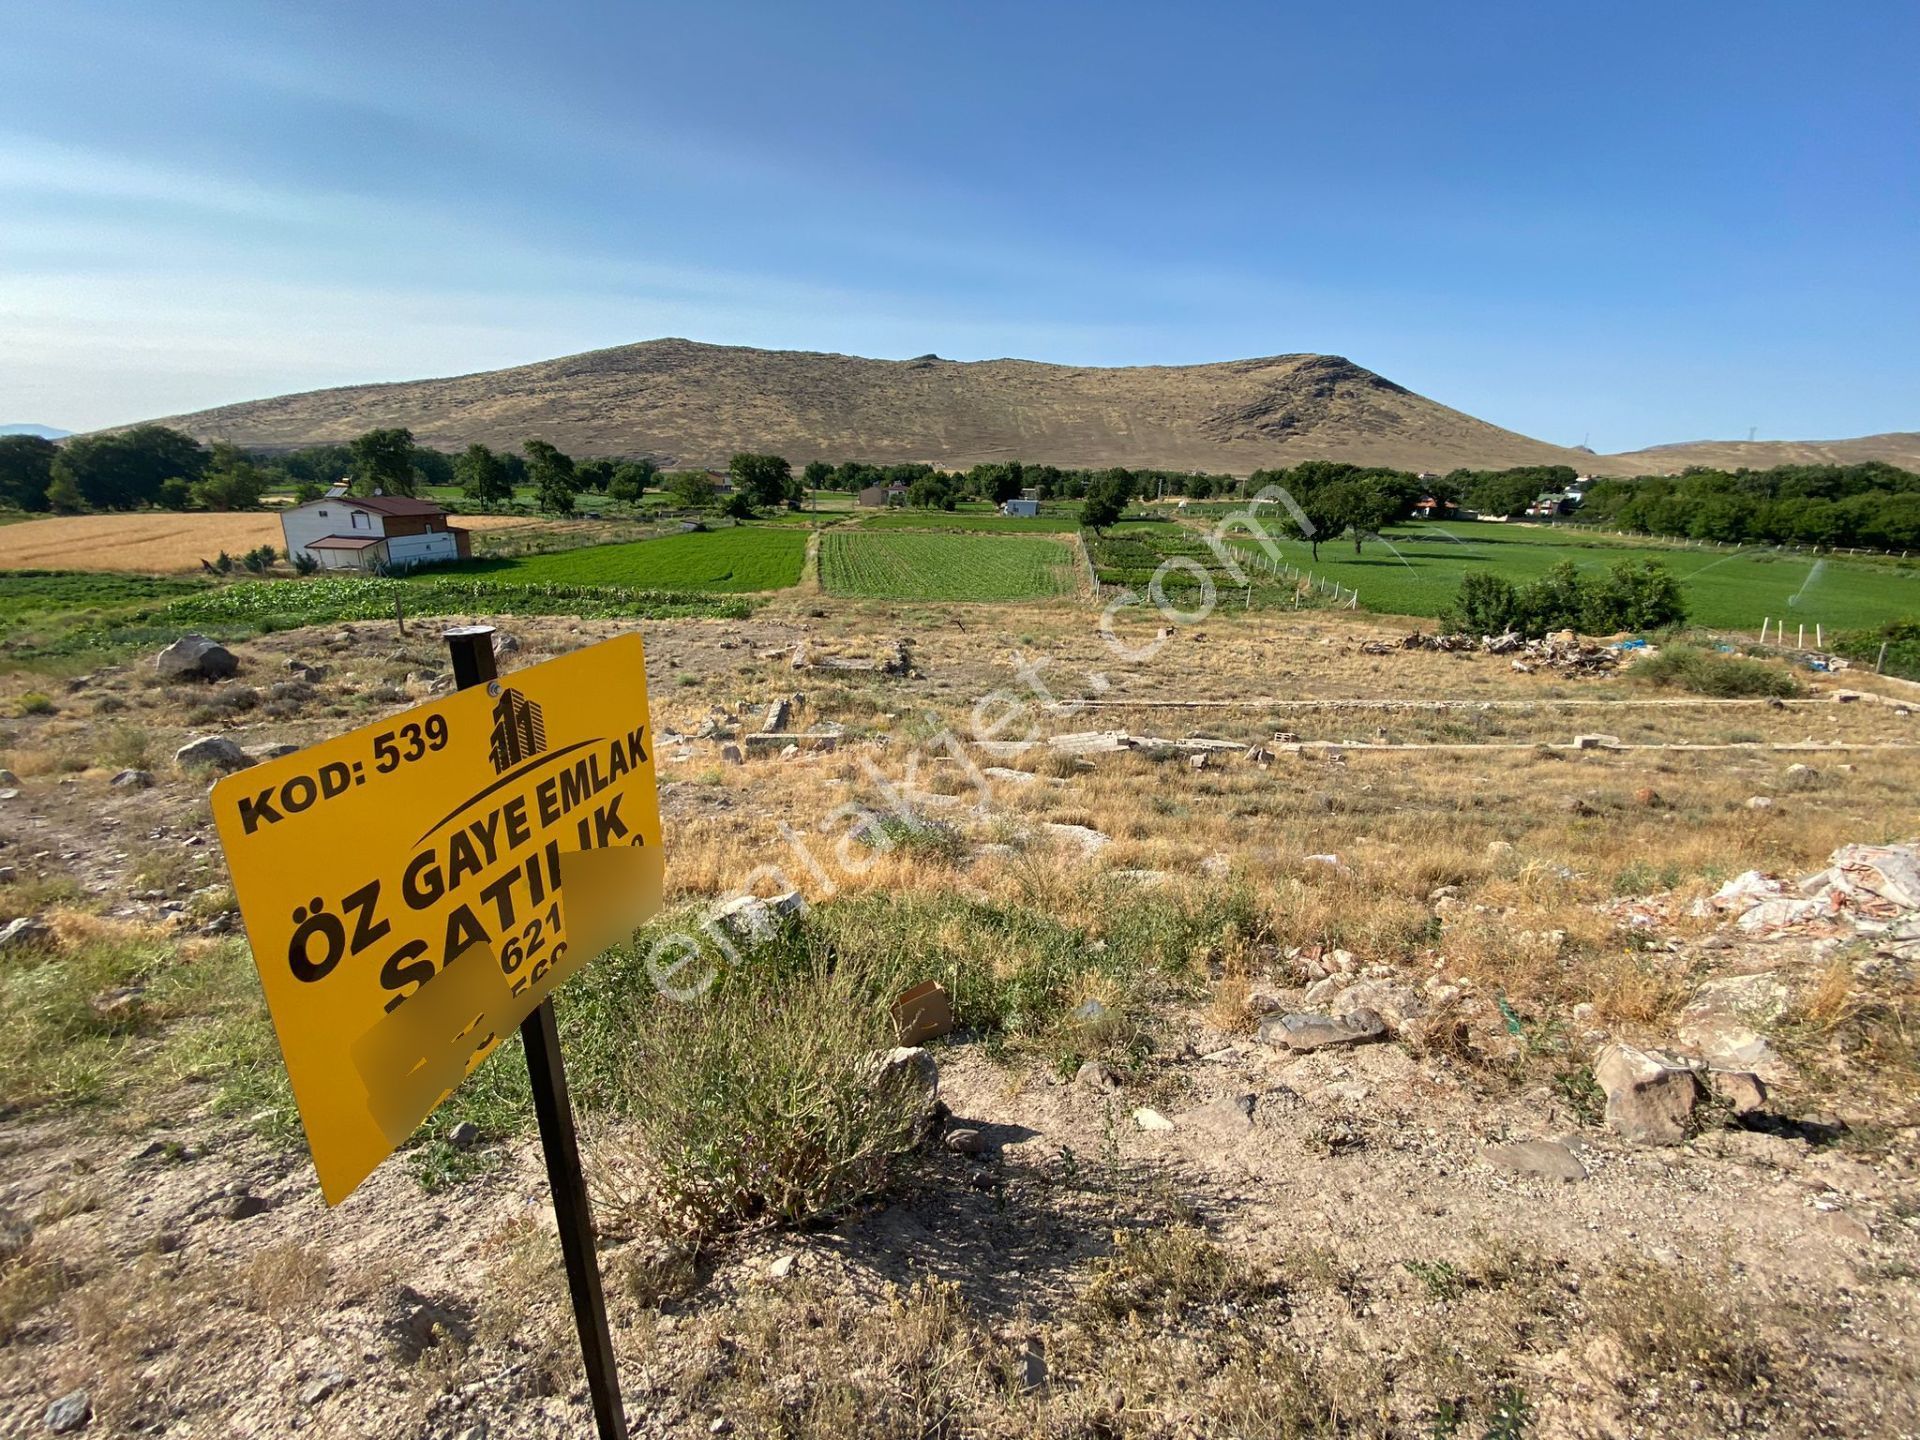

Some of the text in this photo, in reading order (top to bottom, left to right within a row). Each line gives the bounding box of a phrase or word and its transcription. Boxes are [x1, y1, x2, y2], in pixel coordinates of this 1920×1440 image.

[237, 714, 449, 835] KOD: 539
[288, 725, 648, 984] ÖZ GAYE EMLAK
[500, 901, 561, 975] 621
